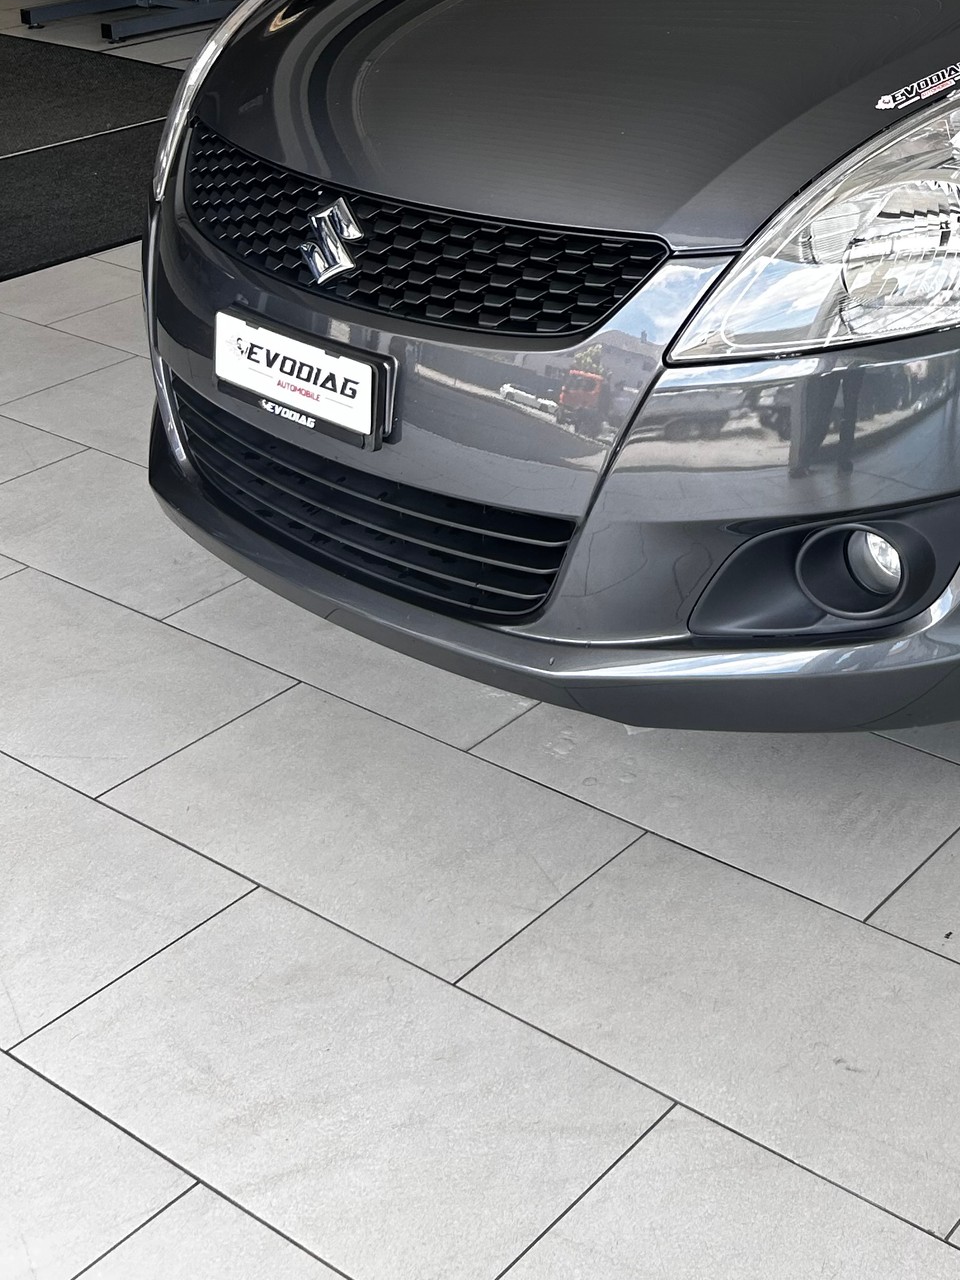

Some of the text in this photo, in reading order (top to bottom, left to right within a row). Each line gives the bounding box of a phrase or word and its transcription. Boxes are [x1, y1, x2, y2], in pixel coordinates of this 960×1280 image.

[246, 342, 360, 400] EVODIAG
[276, 379, 321, 402] AUTOMOBILE
[268, 403, 316, 428] EVODIAG
